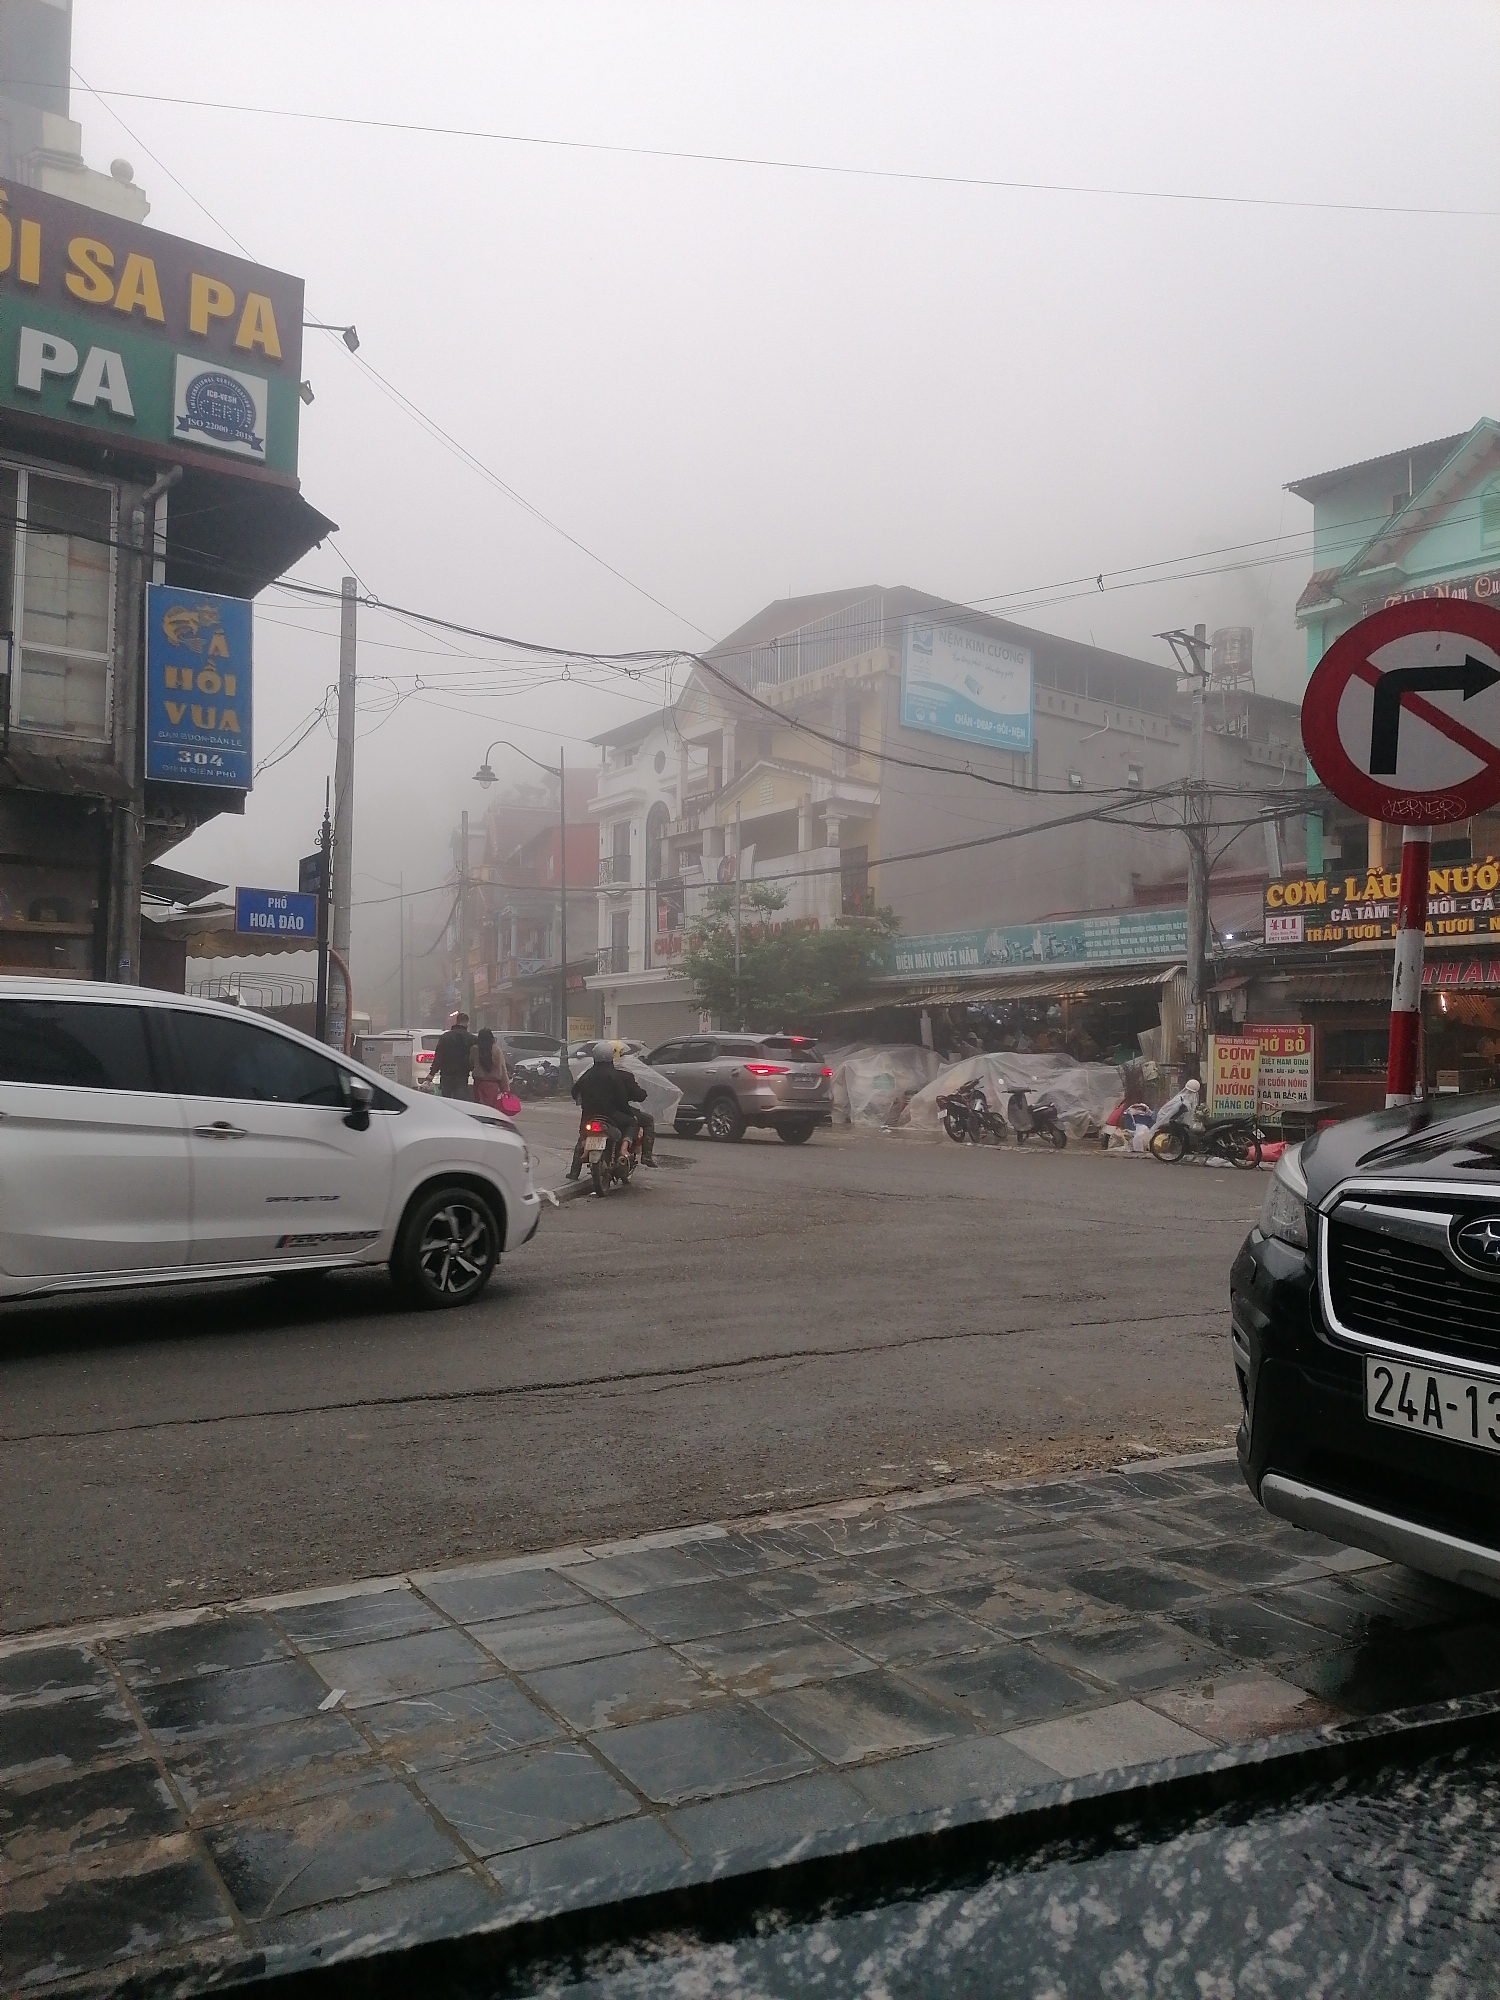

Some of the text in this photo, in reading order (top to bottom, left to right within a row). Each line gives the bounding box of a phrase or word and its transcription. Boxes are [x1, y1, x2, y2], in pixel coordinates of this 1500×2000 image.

[0, 190, 282, 358] I SA PA
[17, 326, 136, 417] PA
[187, 417, 204, 428] ISO
[205, 421, 228, 434] 22000
[234, 429, 253, 441] 2018
[965, 638, 985, 654] KIM
[163, 700, 243, 733] VUA
[178, 750, 224, 767] 304
[267, 895, 288, 909] PHỐ
[1266, 880, 1327, 908] CƠM
[1471, 892, 1494, 912] CÁ
[250, 912, 305, 931] HOA ĐÀO
[1269, 918, 1298, 930] 411
[915, 949, 932, 969] MÁY
[933, 945, 958, 969] QUYẾT
[1260, 1034, 1306, 1052] HỞ BÒ
[1218, 1047, 1255, 1061] CƠM
[1276, 1058, 1291, 1066] NAM
[1215, 1081, 1255, 1096] NƯỚNG
